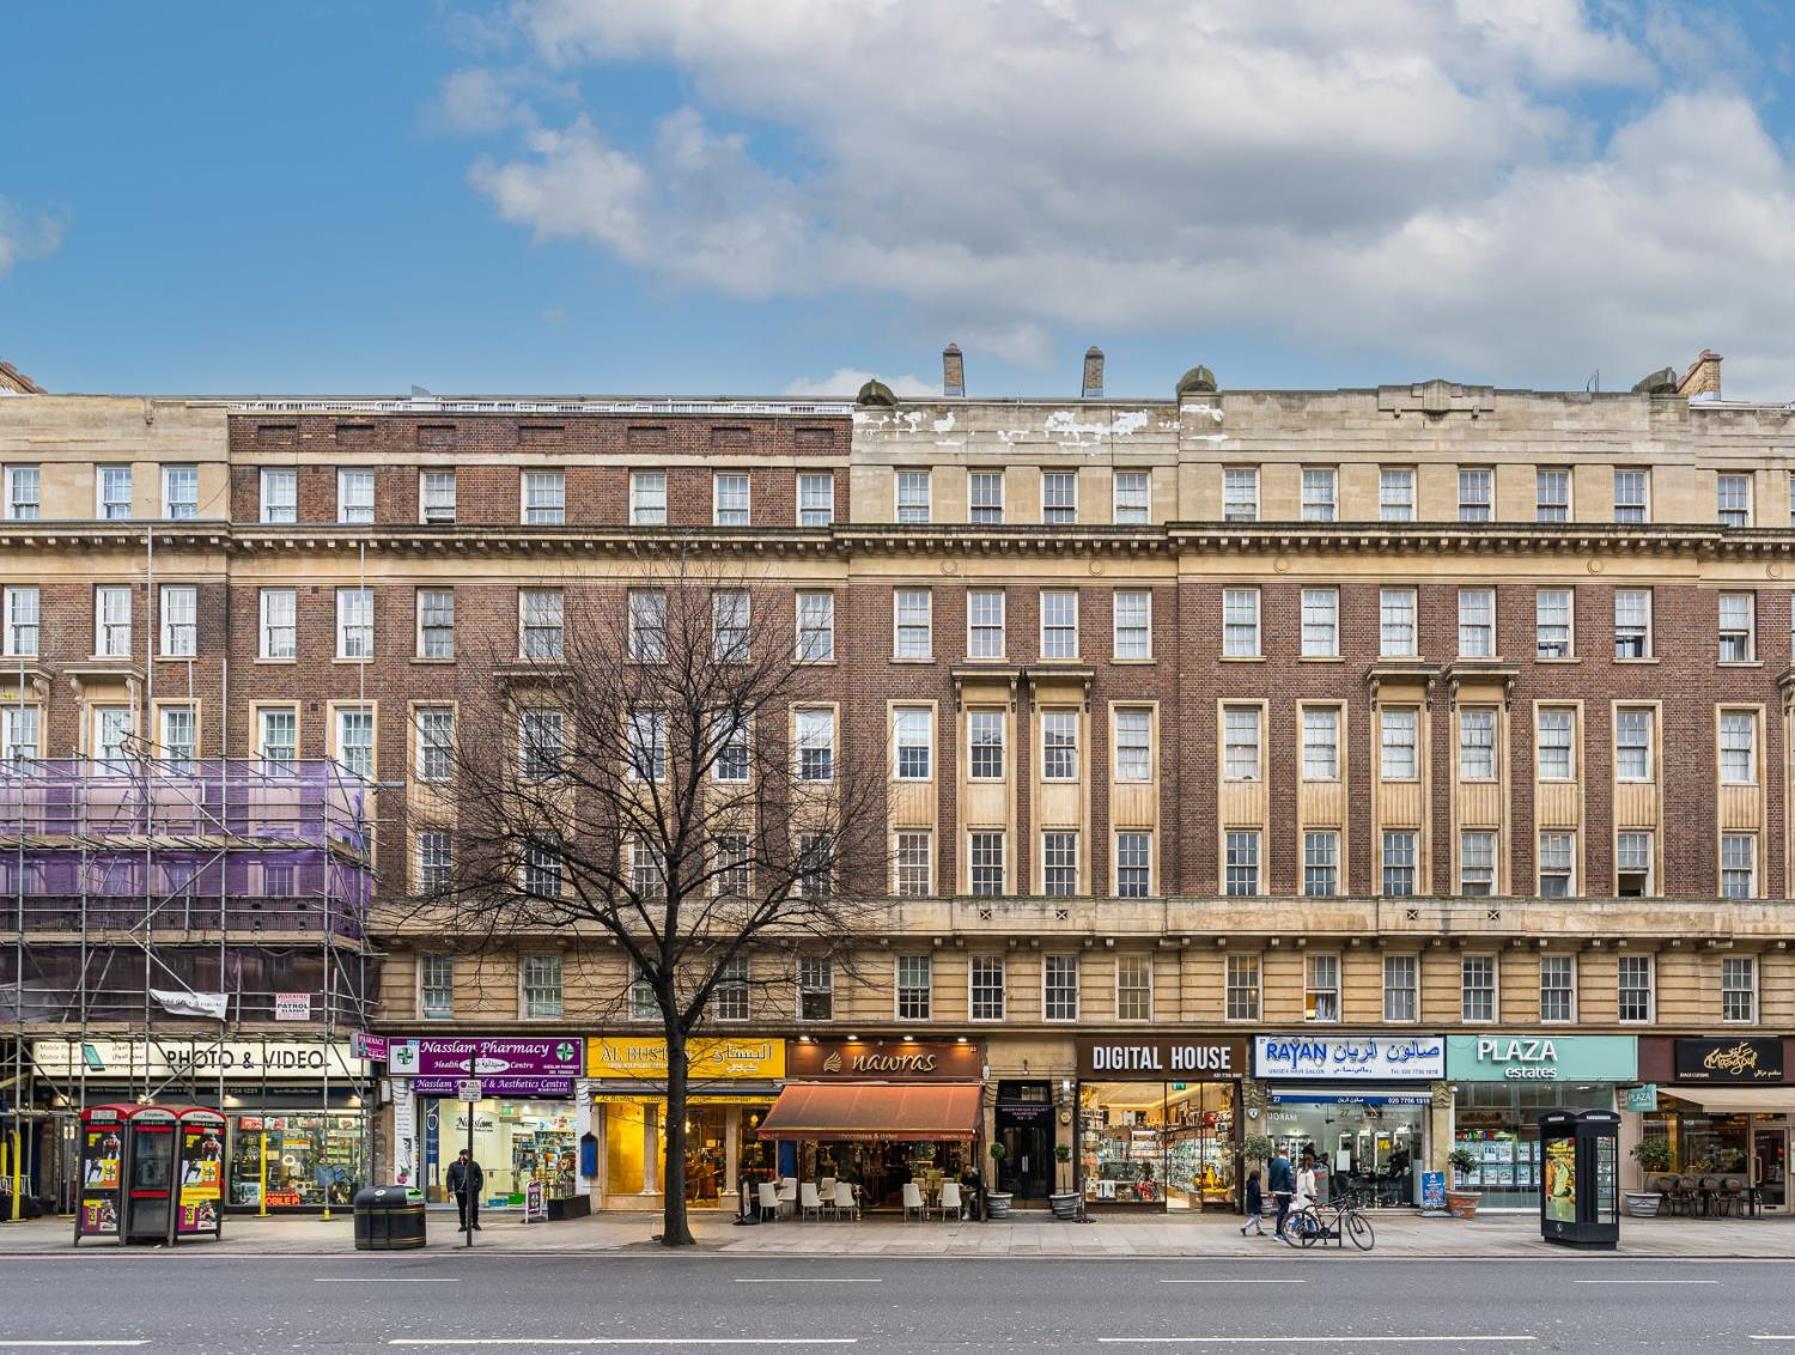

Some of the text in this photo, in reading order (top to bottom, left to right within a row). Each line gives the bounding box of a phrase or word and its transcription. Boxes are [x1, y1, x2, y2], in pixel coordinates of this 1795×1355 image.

[420, 1041, 549, 1058] Nasslam Pharmacy
[601, 1047, 622, 1061] AL
[1093, 1046, 1231, 1070] DIGITAL HOUSE
[1266, 1042, 1327, 1068] RAYAN
[1333, 1039, 1440, 1064] صالون الريان
[1477, 1040, 1558, 1061] PLAZA
[166, 1050, 324, 1069] PHOTO & VIDEO
[510, 1061, 534, 1069] Centre
[852, 1053, 937, 1072] nawras
[1505, 1065, 1558, 1079] estates
[416, 1079, 452, 1088] Nasslam
[497, 1079, 538, 1088] Aesthetics
[540, 1079, 568, 1088] Centre
